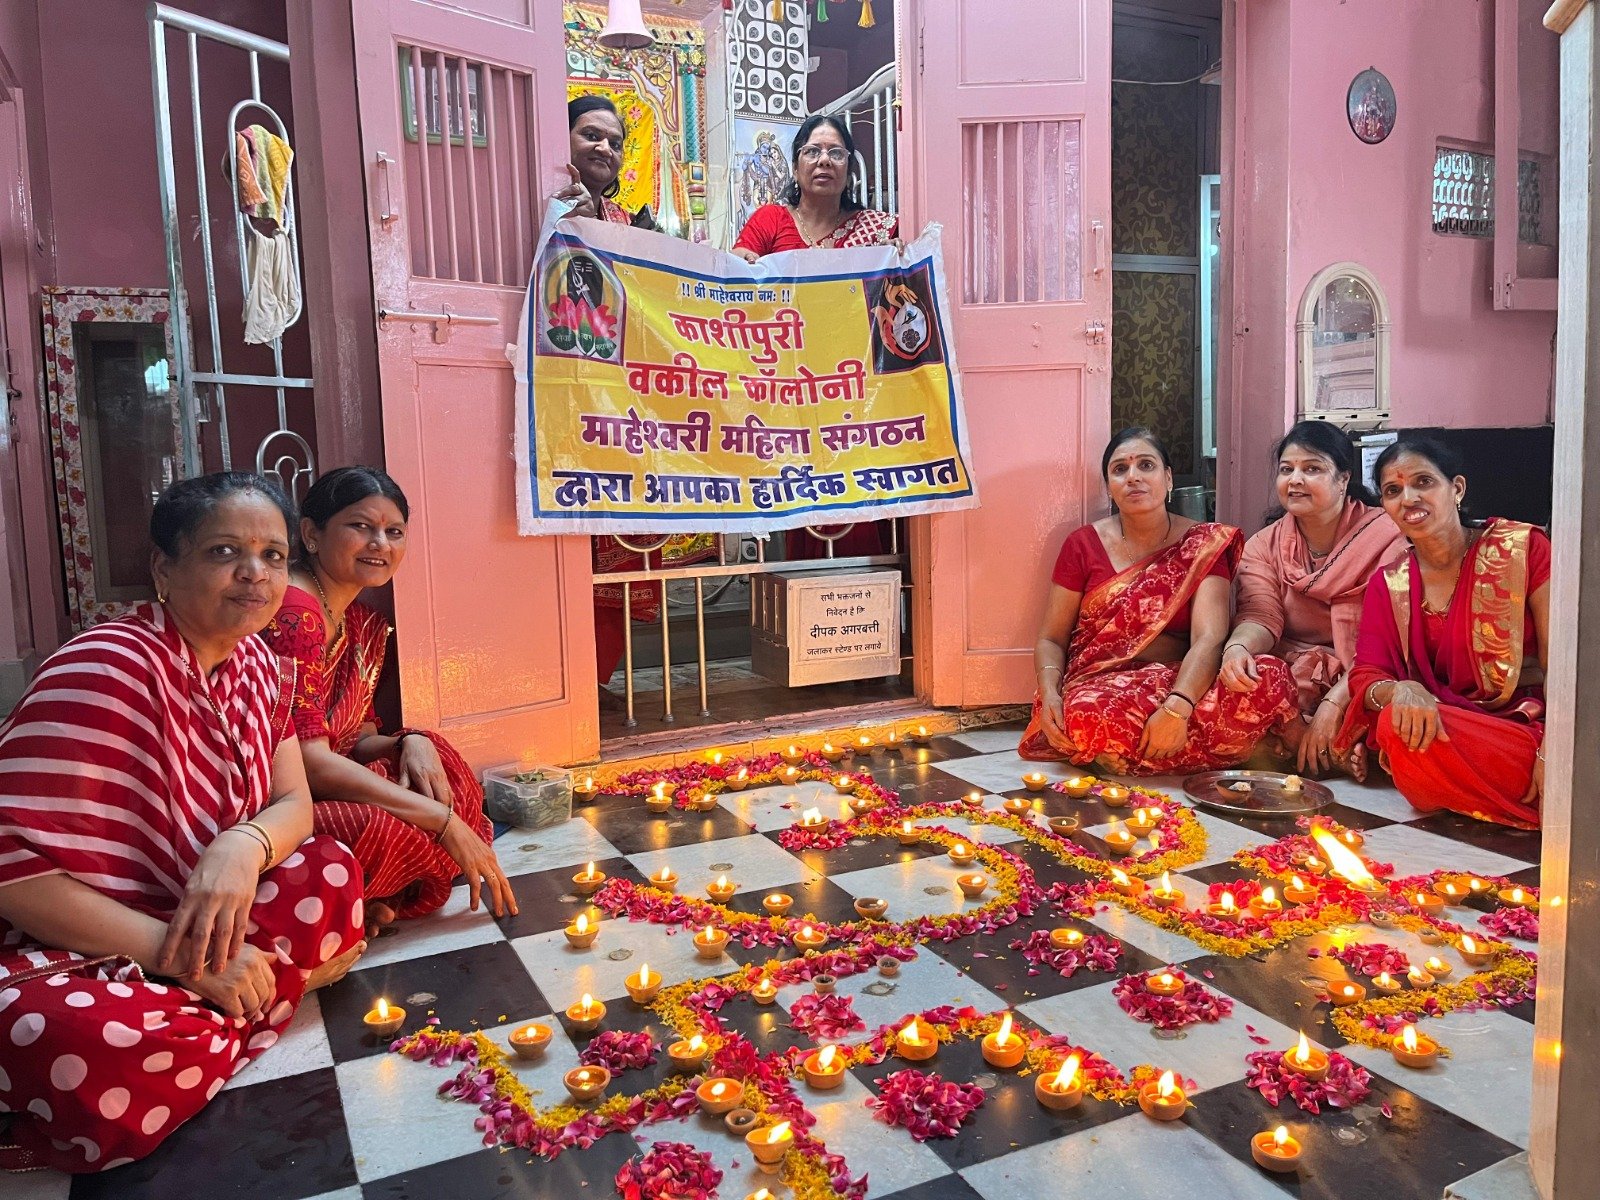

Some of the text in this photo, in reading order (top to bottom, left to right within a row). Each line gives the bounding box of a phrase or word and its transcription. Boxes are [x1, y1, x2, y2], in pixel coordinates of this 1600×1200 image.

[694, 282, 706, 299] श्री
[709, 286, 754, 304] माहेश्वराय
[668, 309, 804, 364] काशीपुरी
[626, 352, 866, 406] वकील कॉलोनी
[581, 408, 925, 460] माहेश्वरी महिला संगठन
[552, 457, 960, 509] द्वारा आपका हार्दिक स्वागत
[821, 590, 872, 602] सभी भक्तजनों से
[826, 606, 865, 617] निवेदन है कि
[810, 620, 879, 638] दीपक अगरबत्ती
[807, 648, 832, 656] जलाकर
